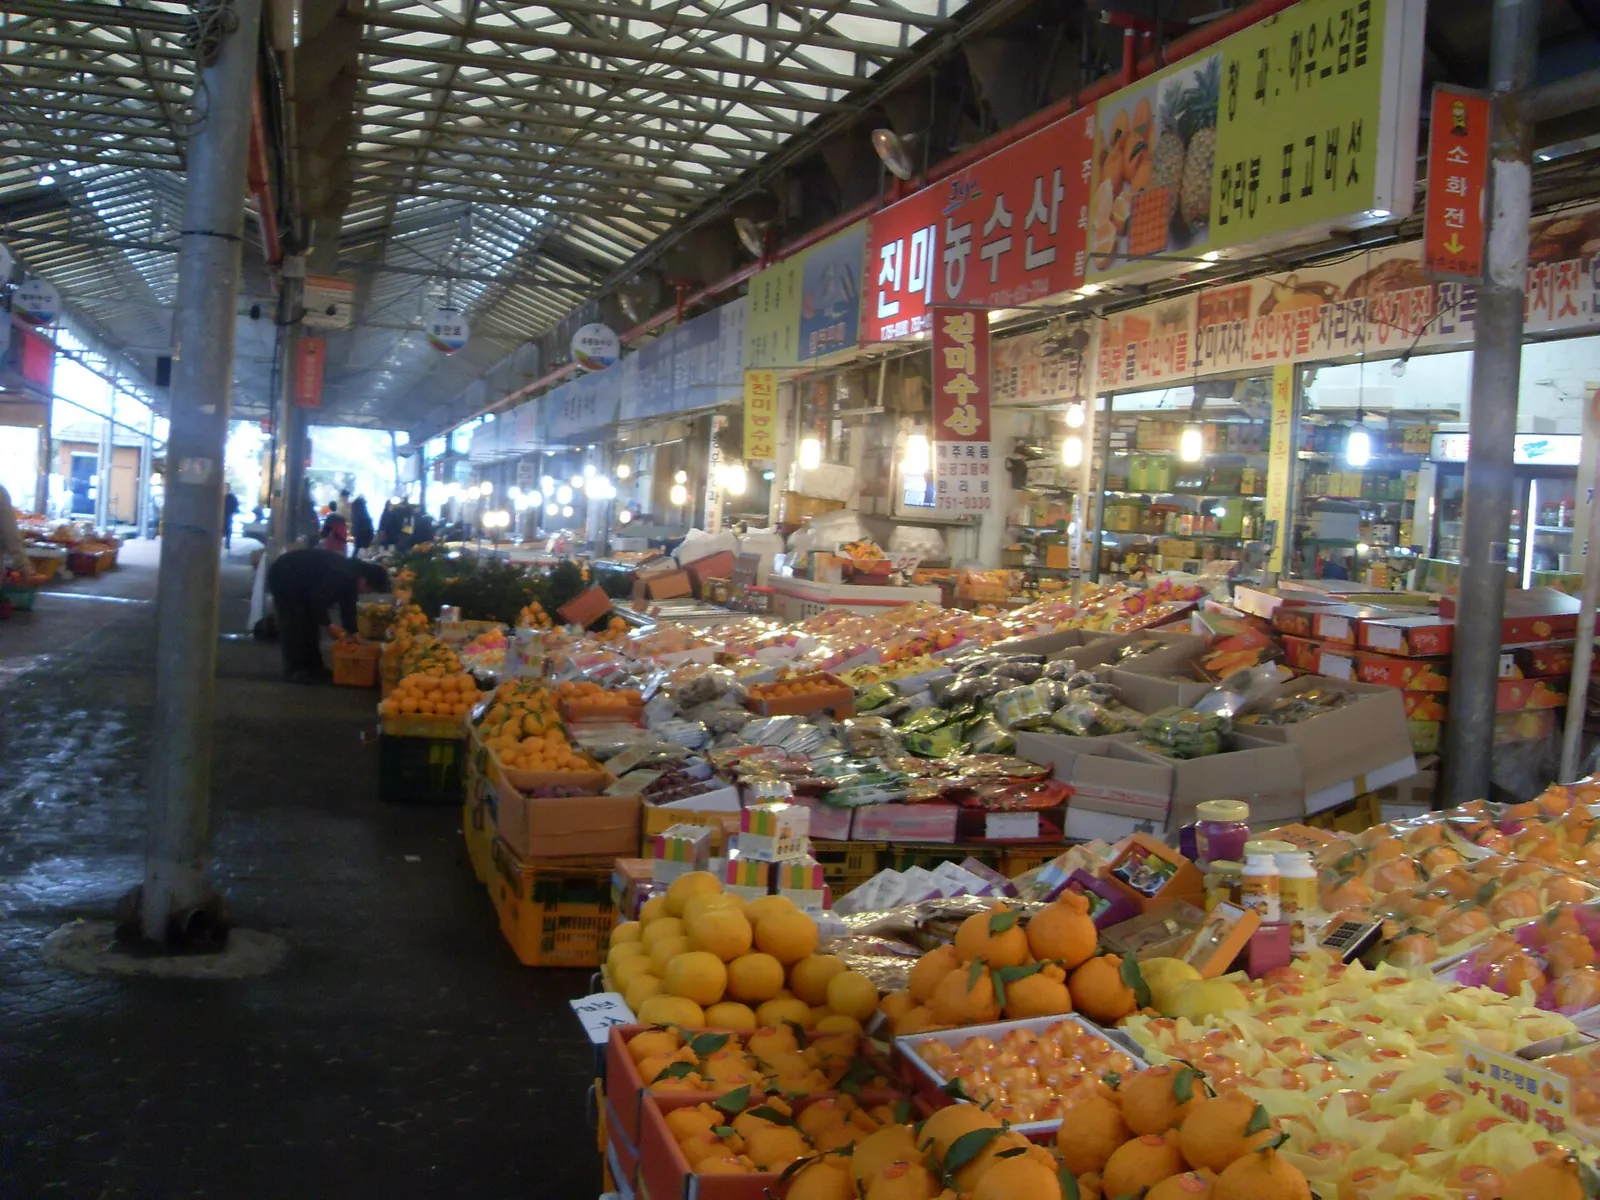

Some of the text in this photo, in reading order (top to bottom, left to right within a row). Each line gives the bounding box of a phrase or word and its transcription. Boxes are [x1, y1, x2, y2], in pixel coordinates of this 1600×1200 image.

[1444, 145, 1469, 229] 소화전
[942, 312, 981, 436] 진미수산
[750, 384, 772, 457] 진미농수산
[938, 445, 989, 458] 제주옥돔
